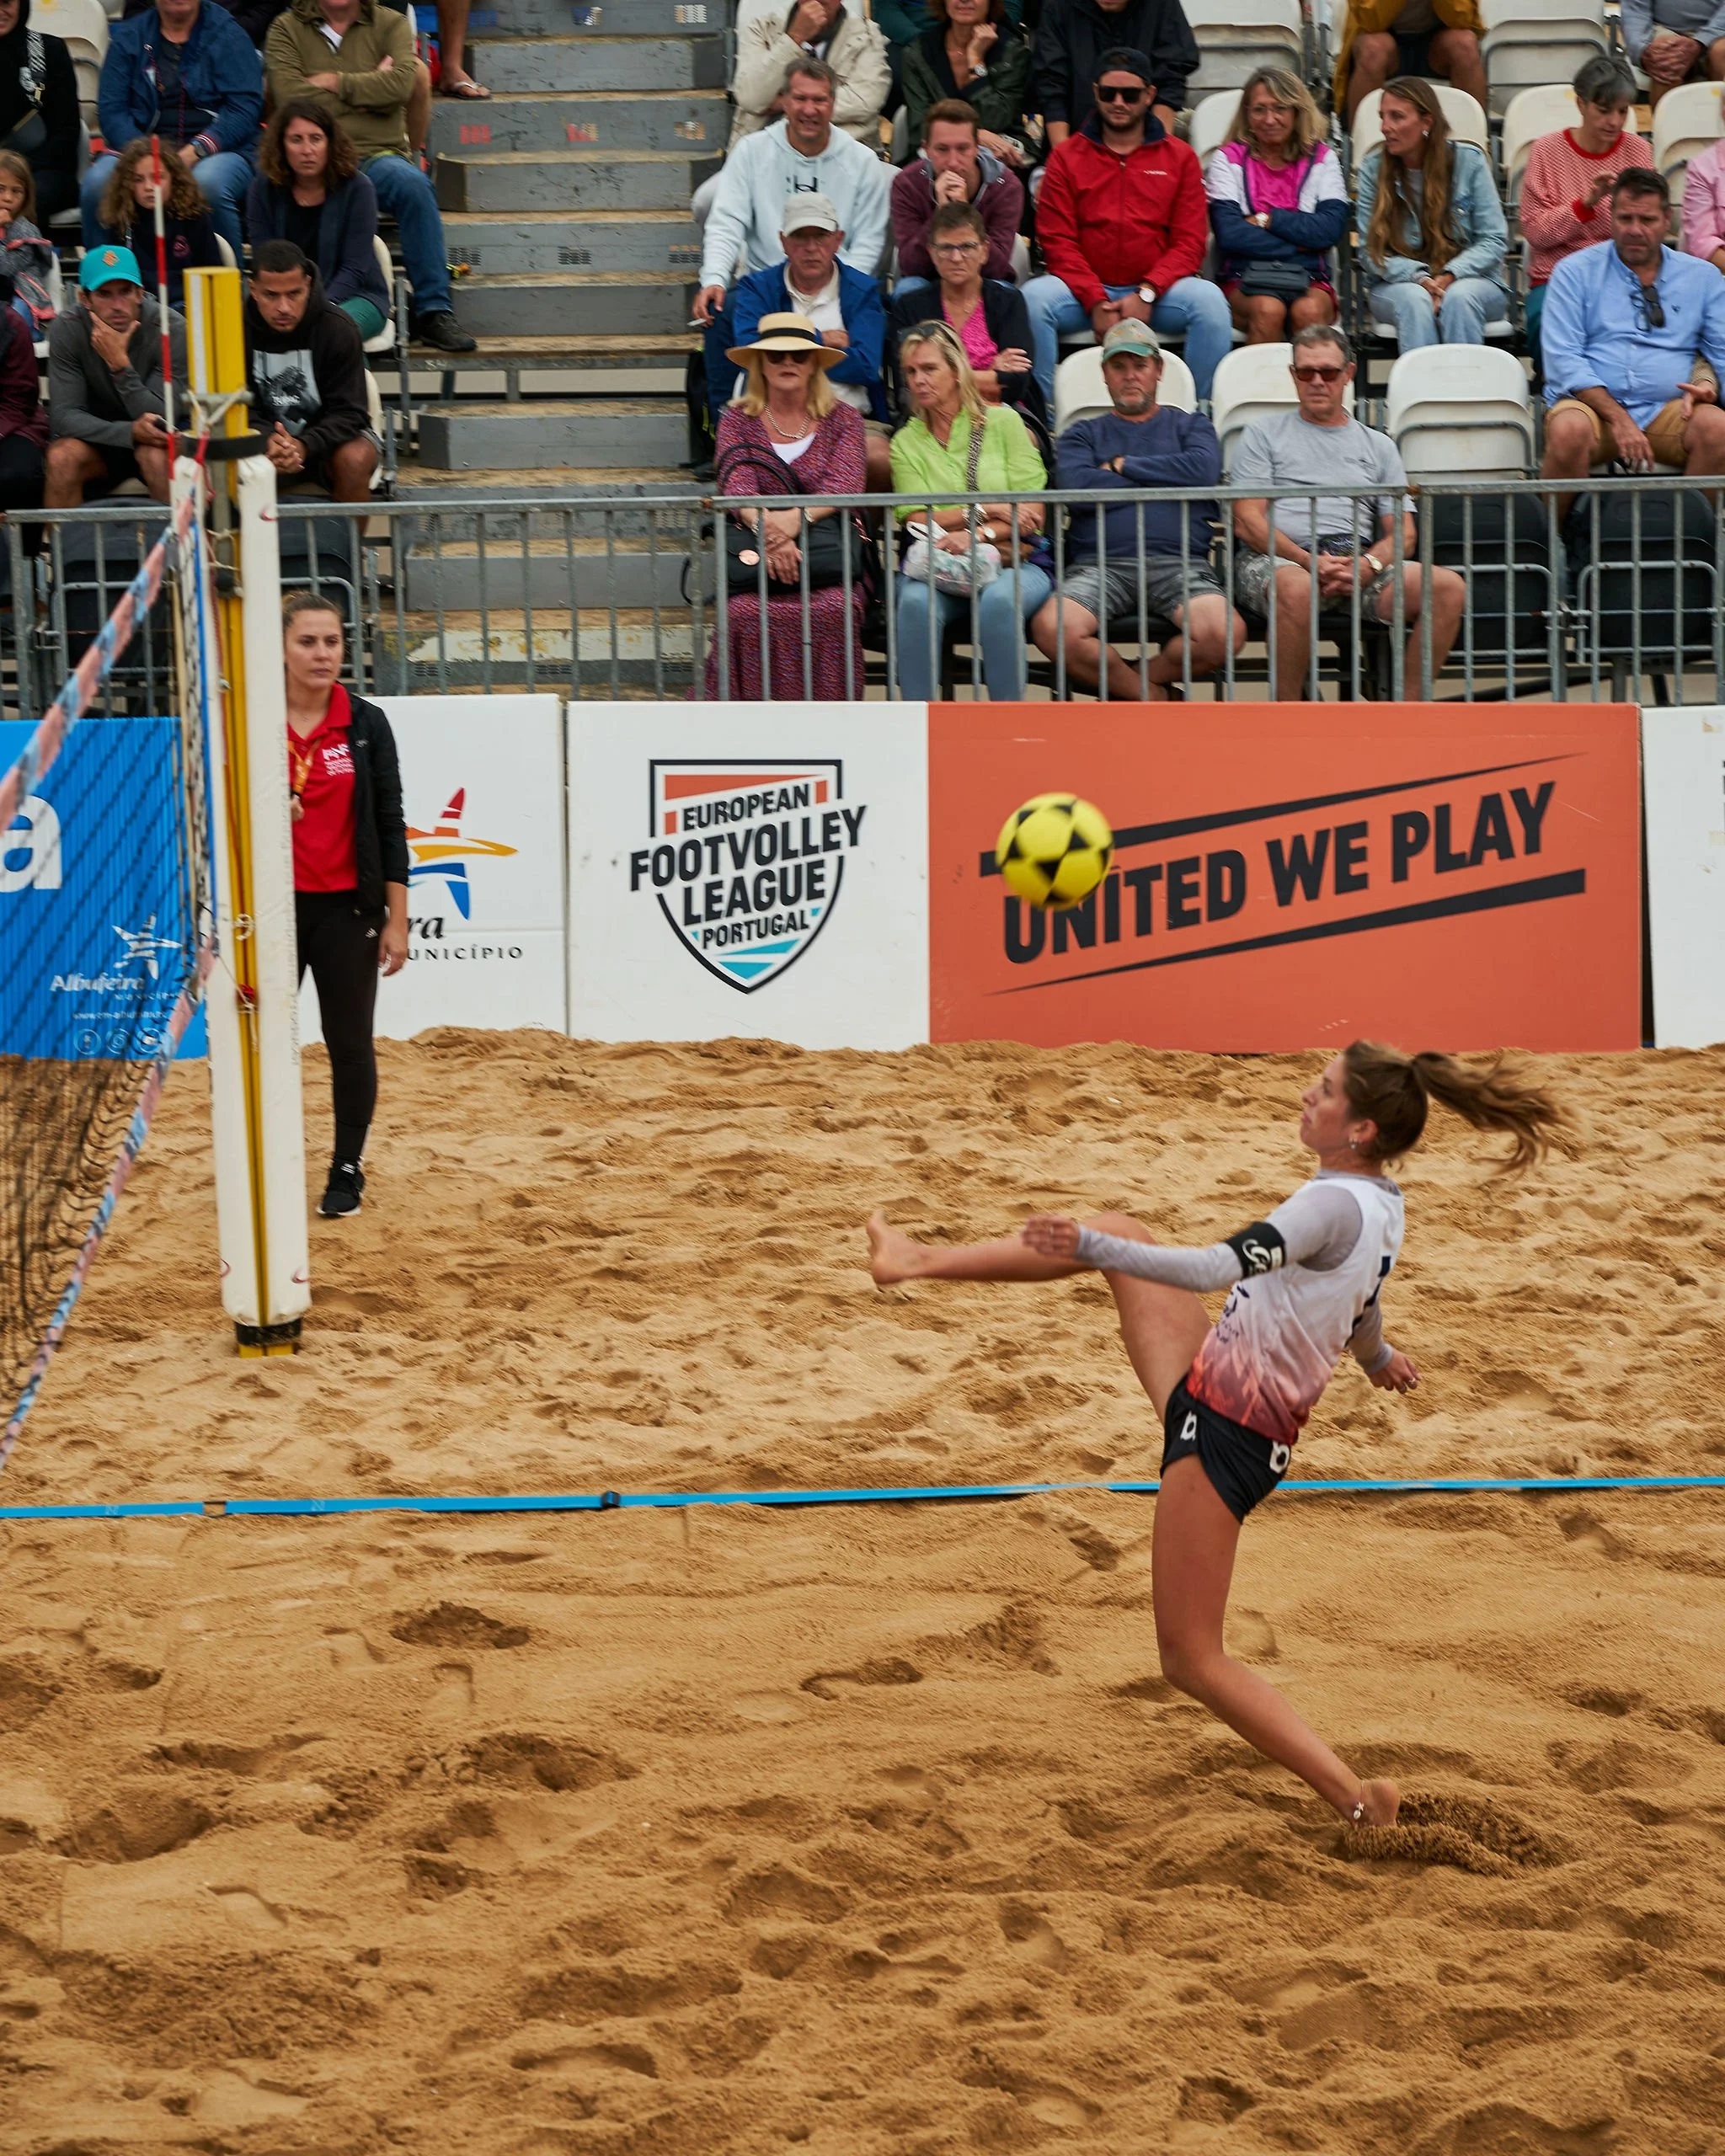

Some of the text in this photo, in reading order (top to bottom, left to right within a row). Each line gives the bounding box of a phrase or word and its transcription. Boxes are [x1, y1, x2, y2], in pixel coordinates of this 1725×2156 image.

[682, 783, 809, 831] EUROPEAN
[629, 805, 868, 893] FOOTVOLLEY
[1004, 780, 1557, 964] UNITED WE PLAY
[683, 859, 826, 926] LEAGUE
[407, 943, 524, 961] UNICÍPIO
[702, 909, 810, 950] PORTUGAL
